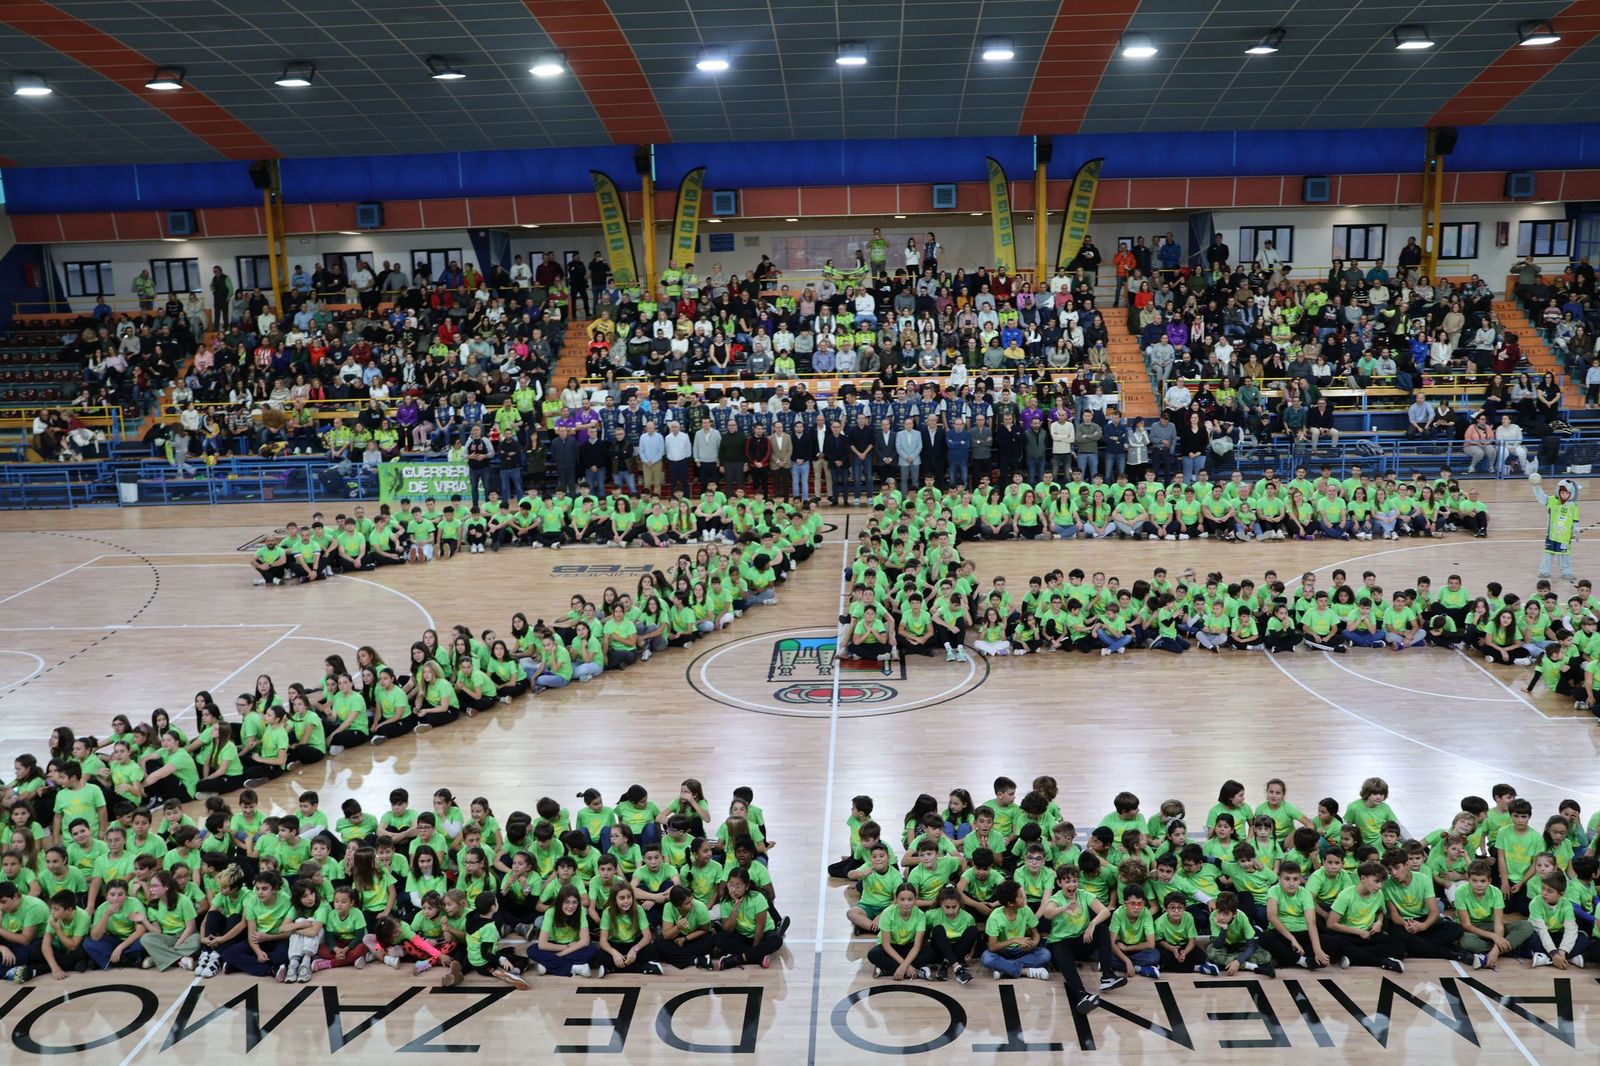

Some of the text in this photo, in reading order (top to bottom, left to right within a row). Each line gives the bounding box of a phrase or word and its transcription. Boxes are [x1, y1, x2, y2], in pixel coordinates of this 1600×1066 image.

[402, 465, 470, 479] GUERRER
[408, 480, 428, 493] DE
[551, 564, 655, 574] FEB
[553, 986, 764, 1054] DE
[830, 976, 1600, 1055] AMIENTO
